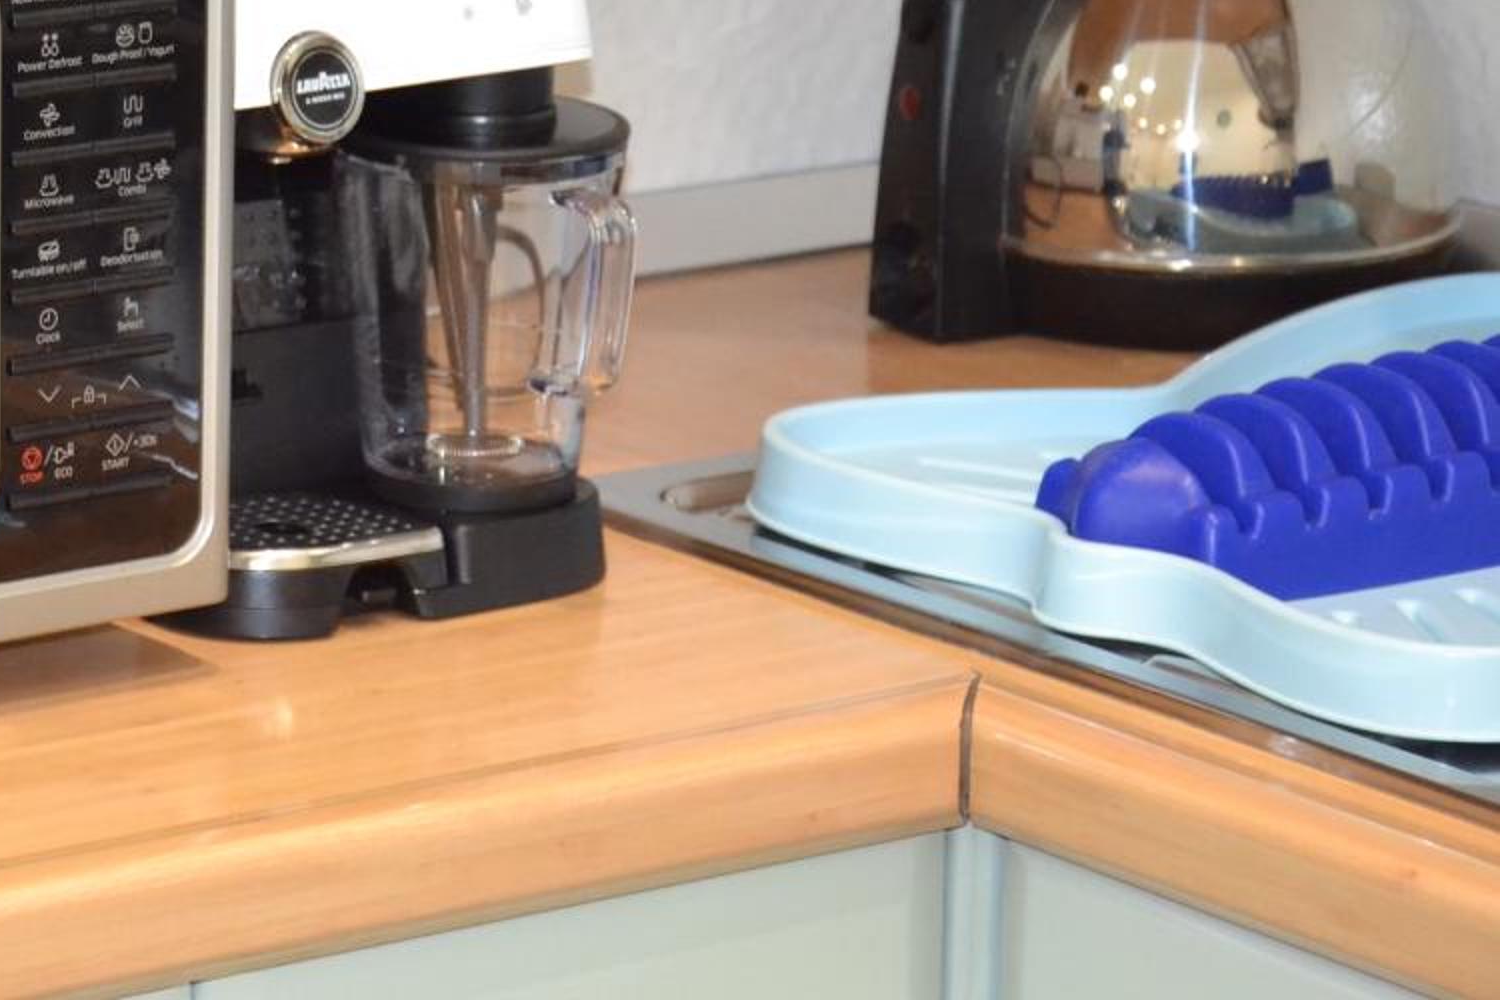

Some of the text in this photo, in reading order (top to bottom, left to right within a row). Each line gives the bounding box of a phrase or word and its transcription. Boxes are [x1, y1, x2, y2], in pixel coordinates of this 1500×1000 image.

[18, 60, 47, 73] Power
[23, 125, 76, 141] Convection
[24, 194, 75, 209] Microwave
[36, 330, 61, 345] Clock
[20, 471, 44, 484] STOP
